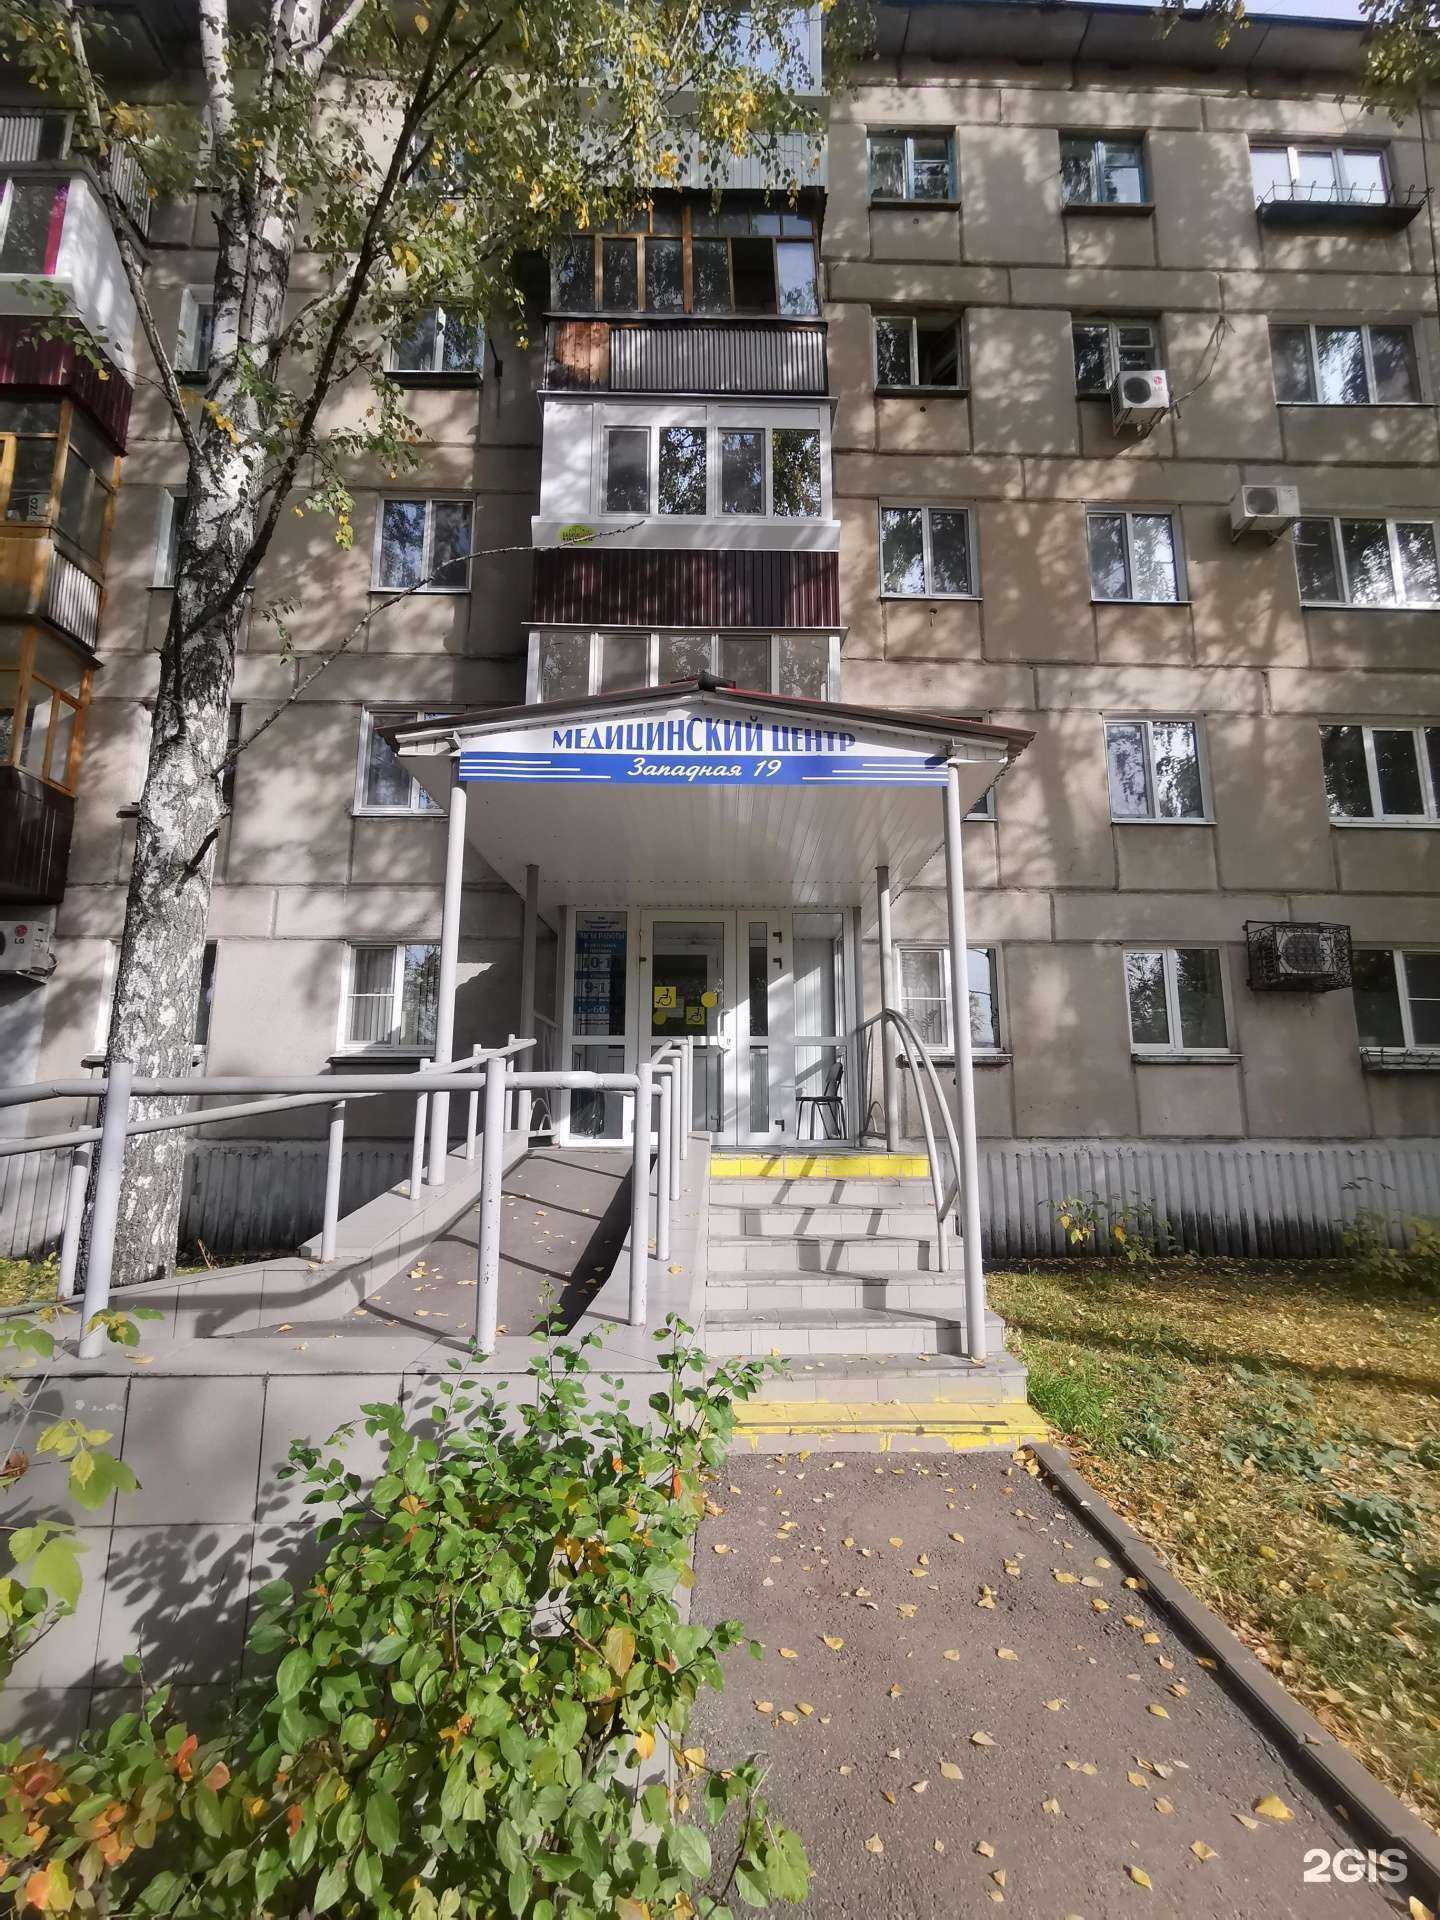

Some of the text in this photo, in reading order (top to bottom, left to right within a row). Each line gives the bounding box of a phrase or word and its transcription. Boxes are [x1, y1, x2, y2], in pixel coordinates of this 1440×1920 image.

[552, 715, 856, 752] МЕДИЦИНСКИЙ ЦЕНТР
[627, 757, 782, 782] Западная 19
